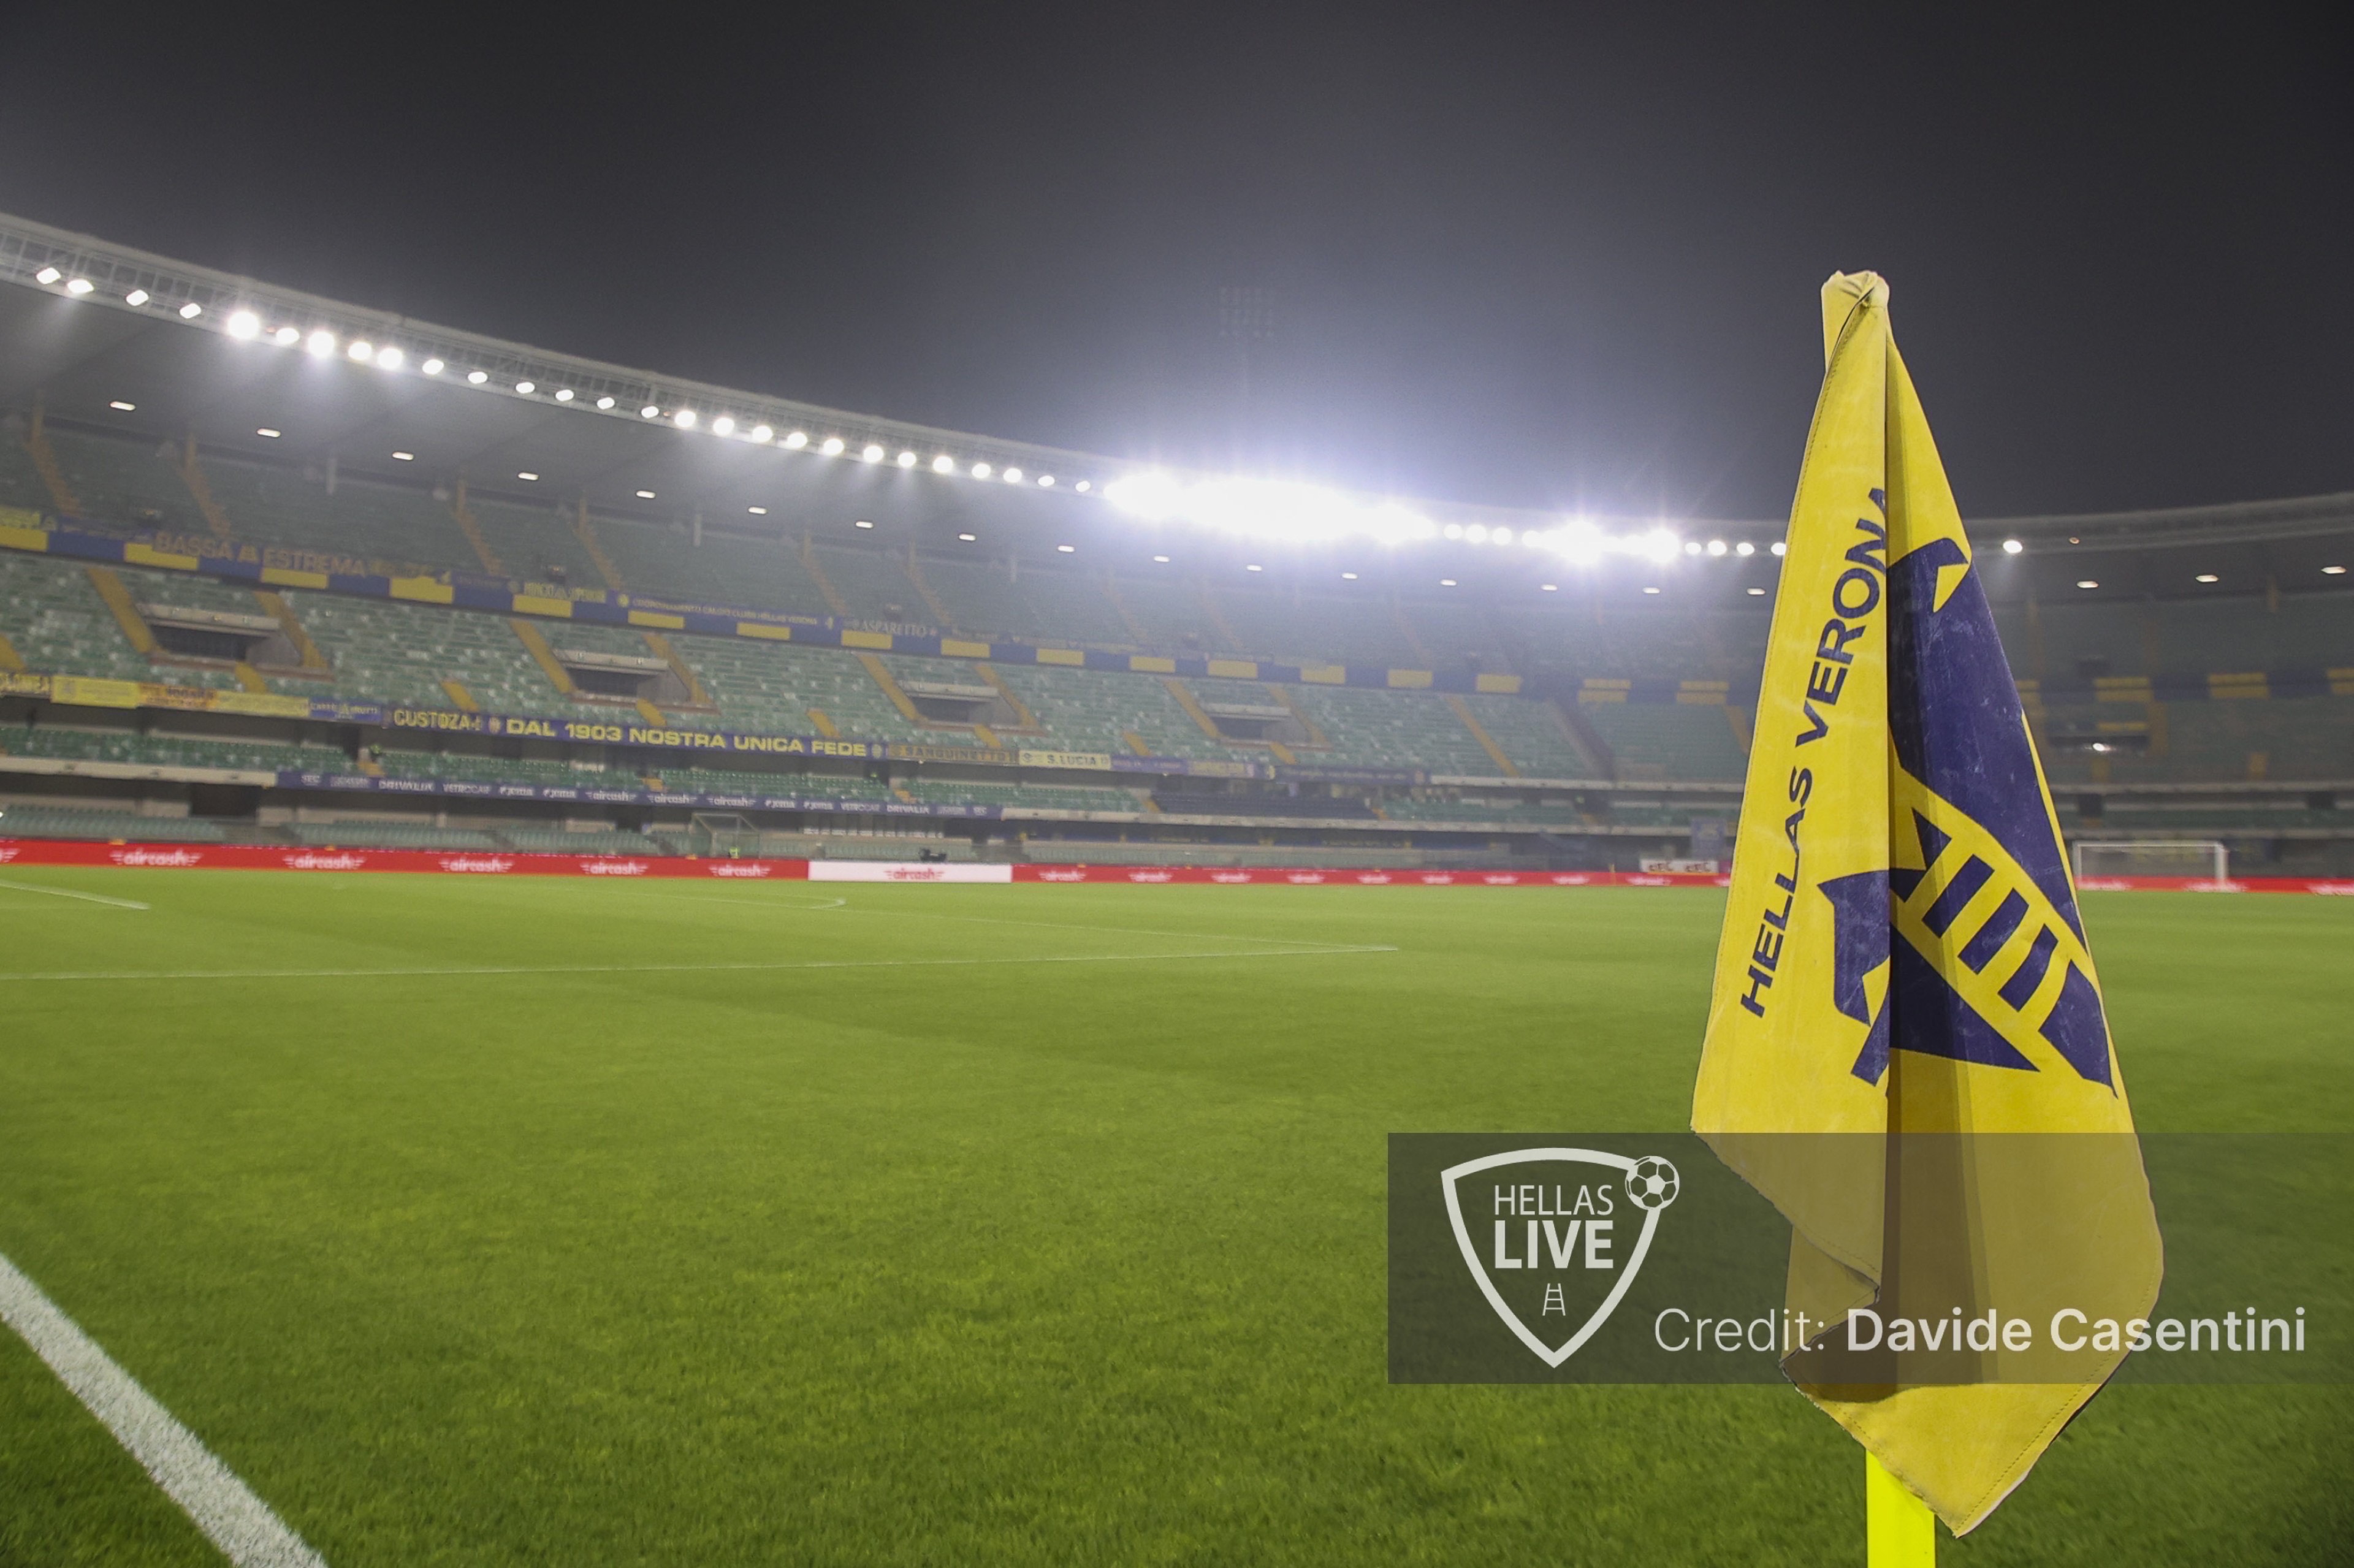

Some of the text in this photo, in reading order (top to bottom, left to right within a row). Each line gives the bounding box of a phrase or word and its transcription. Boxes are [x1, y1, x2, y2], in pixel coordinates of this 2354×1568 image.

[156, 530, 235, 561] BASSA
[263, 548, 367, 577] ESTREMA
[394, 709, 470, 731] CUSTOZA
[506, 718, 866, 757] DAL 1903 NOSTRA UNICA FEDE
[378, 780, 436, 792] DRIVALIA
[593, 790, 629, 801] aircash
[654, 793, 689, 804] aircash
[714, 796, 747, 806] aircash
[123, 847, 189, 866] aircash
[295, 853, 352, 869] aircash
[449, 857, 502, 872] aircash
[590, 861, 638, 876] aircash
[718, 864, 761, 877] aircash
[893, 868, 935, 880] aircash
[1740, 765, 1813, 1018] HELLAS
